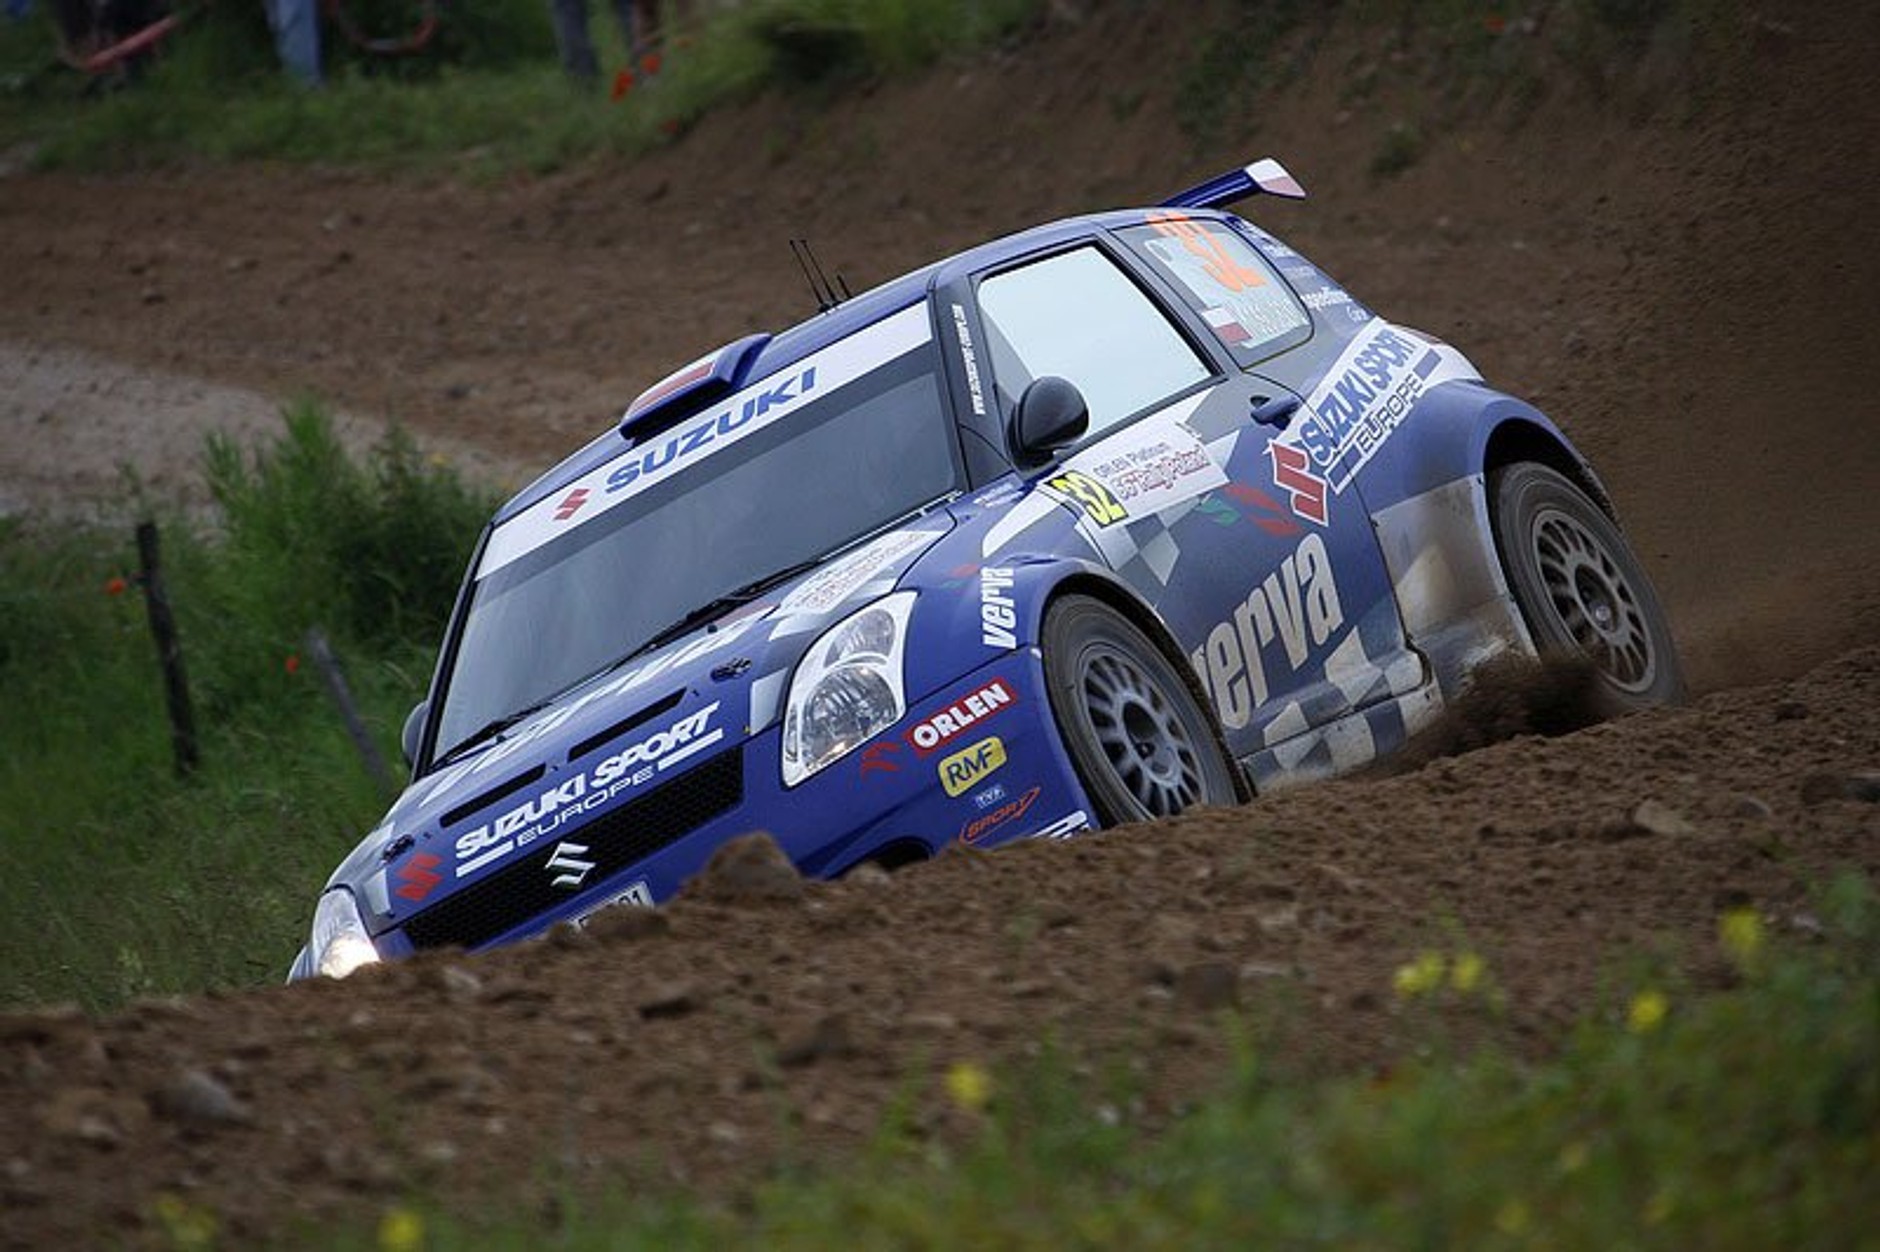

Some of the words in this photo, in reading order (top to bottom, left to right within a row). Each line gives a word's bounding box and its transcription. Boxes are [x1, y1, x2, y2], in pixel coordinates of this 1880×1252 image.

[605, 366, 816, 495] SUZUKI
[1299, 368, 1377, 466] SUZUKI
[1353, 328, 1417, 390] SPORT
[1355, 373, 1423, 452] EUROPE
[1051, 471, 1128, 525] 32
[913, 682, 1011, 748] ORLEN
[456, 773, 586, 859] SUZUKI
[590, 700, 721, 789] SPORT
[945, 742, 997, 788] RMF
[517, 766, 654, 847] EUROPE
